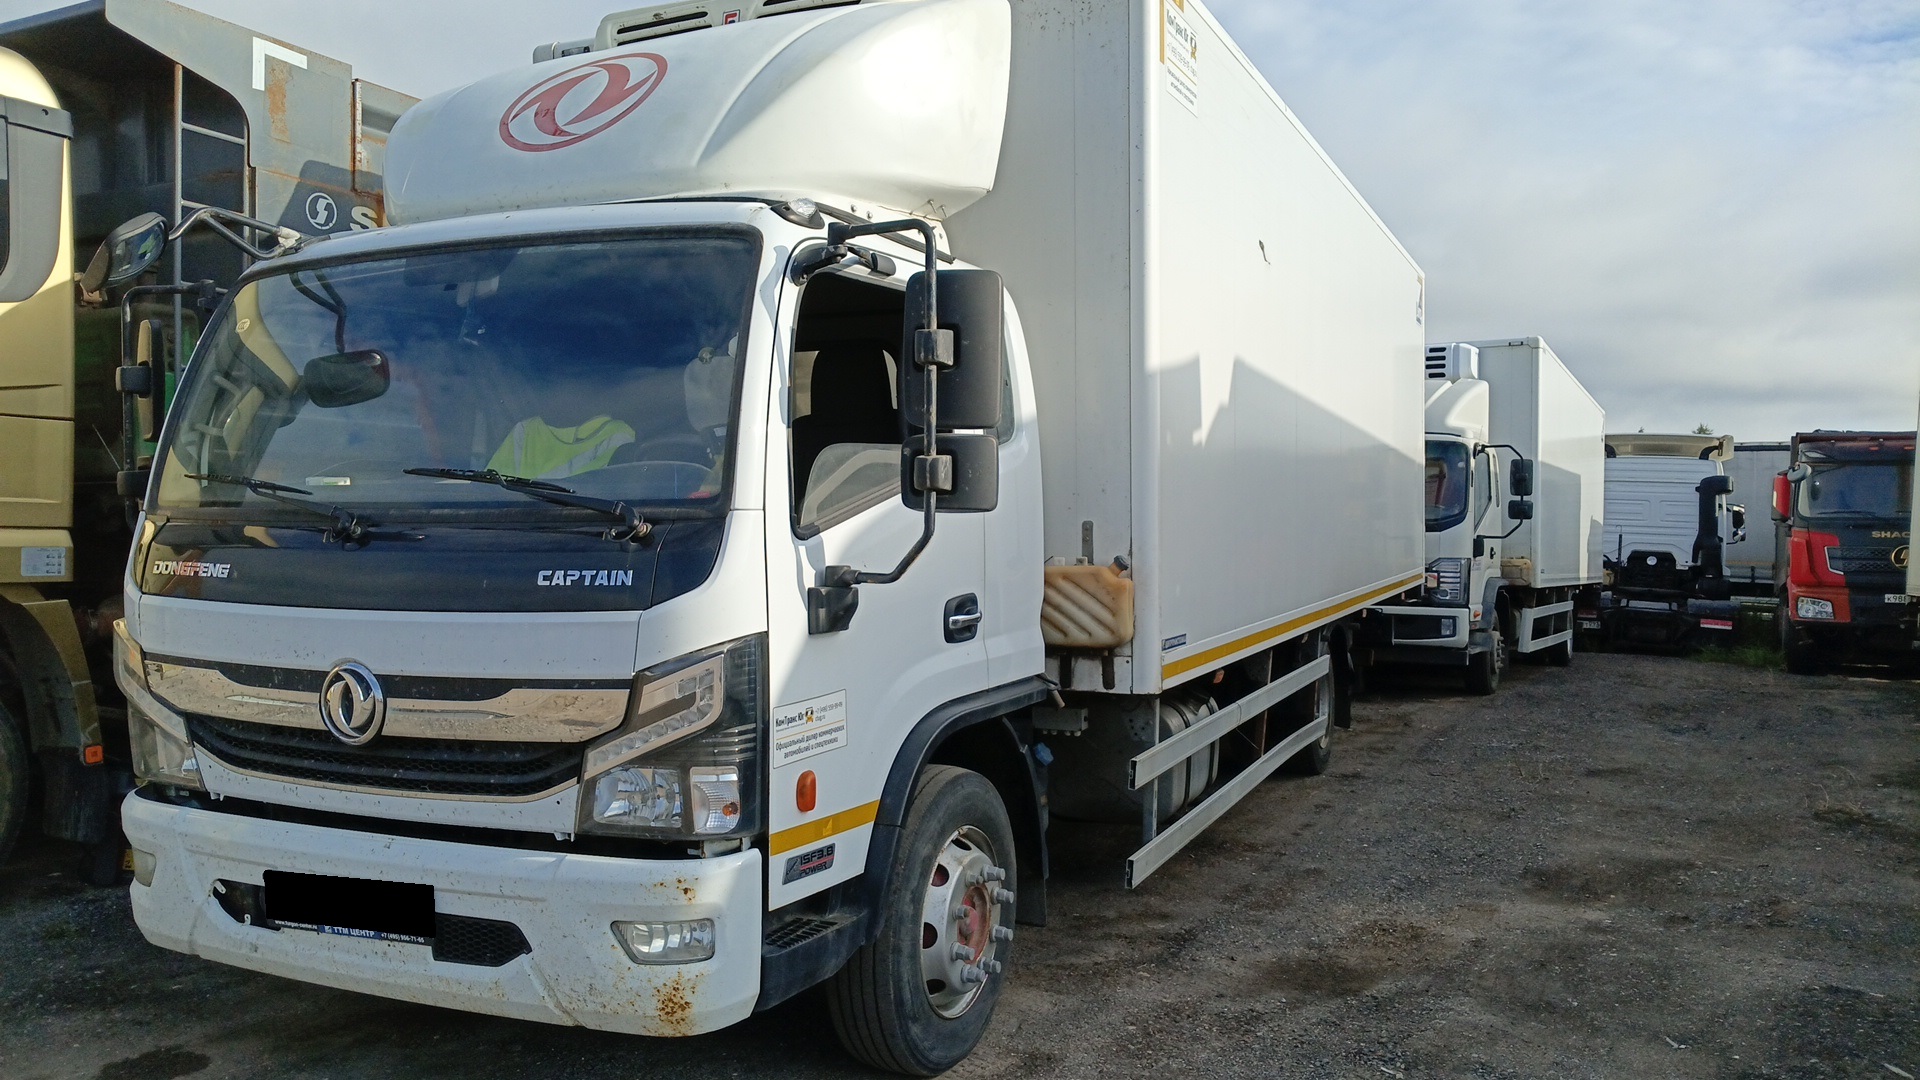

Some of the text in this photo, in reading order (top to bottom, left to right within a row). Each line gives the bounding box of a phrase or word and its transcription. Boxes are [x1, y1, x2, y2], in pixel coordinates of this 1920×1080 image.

[153, 560, 231, 578] DONGFENG
[537, 570, 633, 586] CAPTAIN
[800, 862, 828, 876] POWER
[333, 927, 375, 937] ТТМ ЦЕНТР
